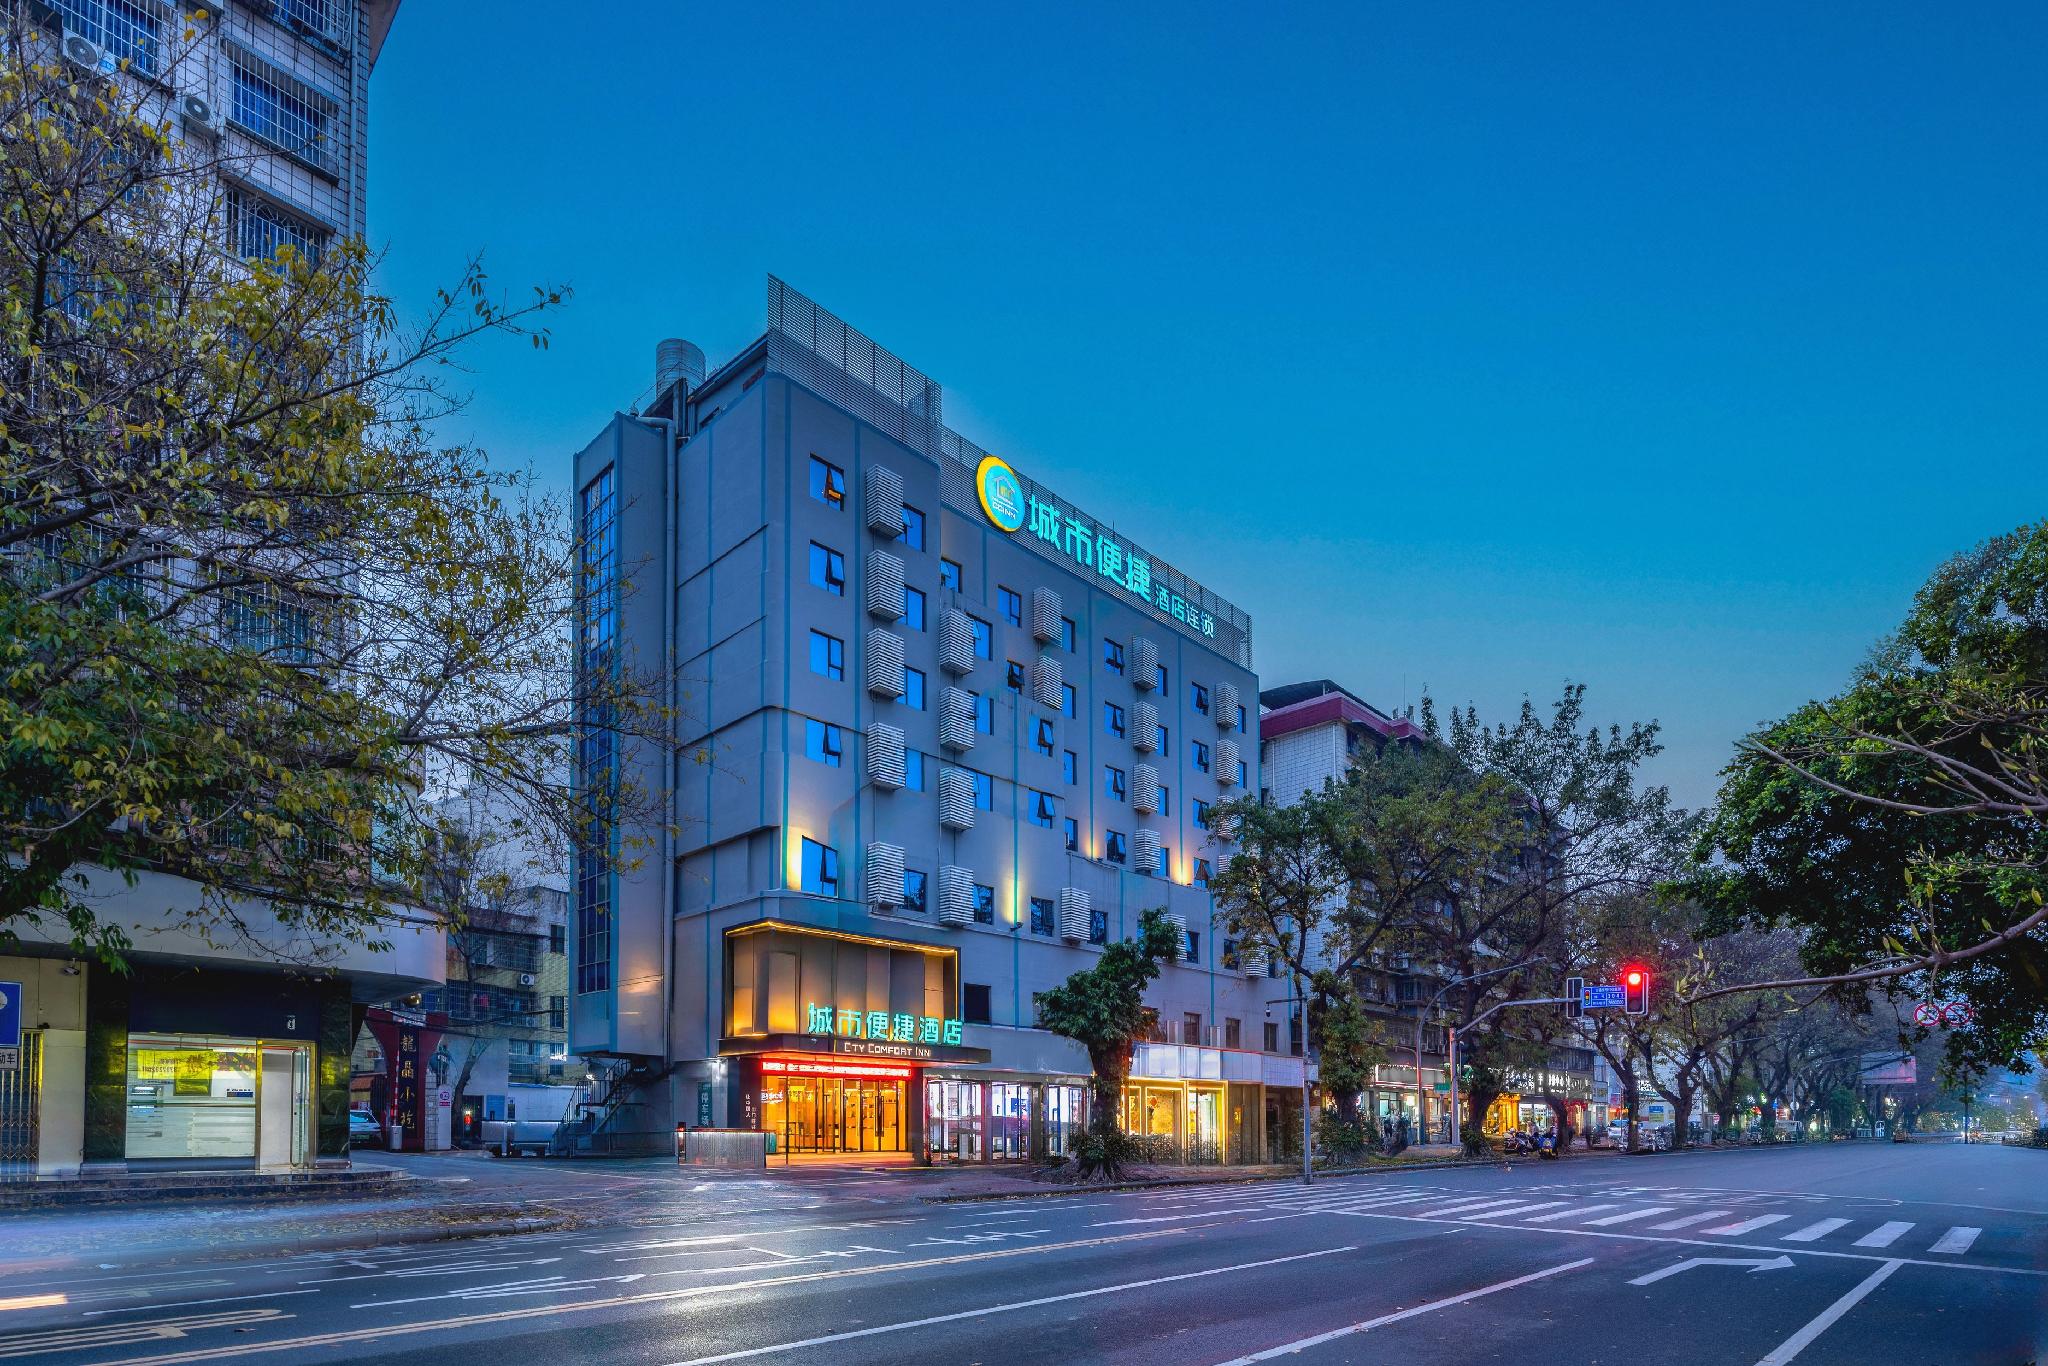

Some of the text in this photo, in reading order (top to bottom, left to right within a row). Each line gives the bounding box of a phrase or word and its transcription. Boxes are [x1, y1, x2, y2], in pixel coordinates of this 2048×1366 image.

[1028, 493, 1215, 639] 城市便捷 酒店连锁
[807, 1002, 965, 1046] 城市便捷酒店
[868, 1043, 913, 1056] COMFORT
[915, 1046, 932, 1057] INN
